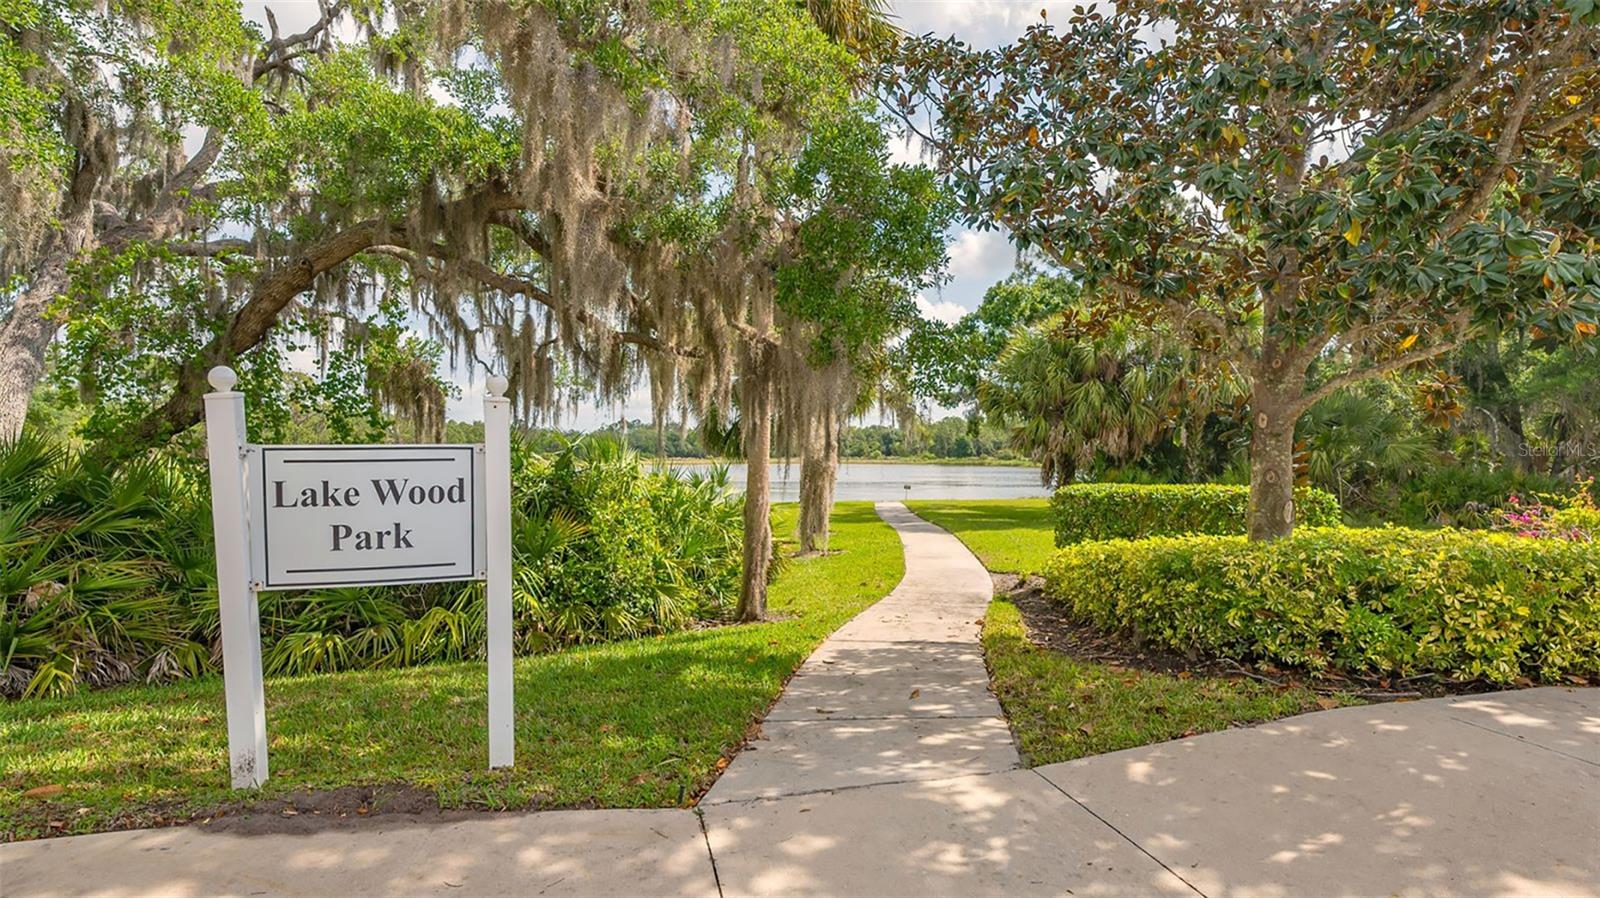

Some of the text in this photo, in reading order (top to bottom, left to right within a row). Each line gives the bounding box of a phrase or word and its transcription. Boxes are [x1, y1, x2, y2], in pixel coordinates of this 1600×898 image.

[272, 477, 466, 508] Lake Wood
[330, 522, 414, 551] Park
